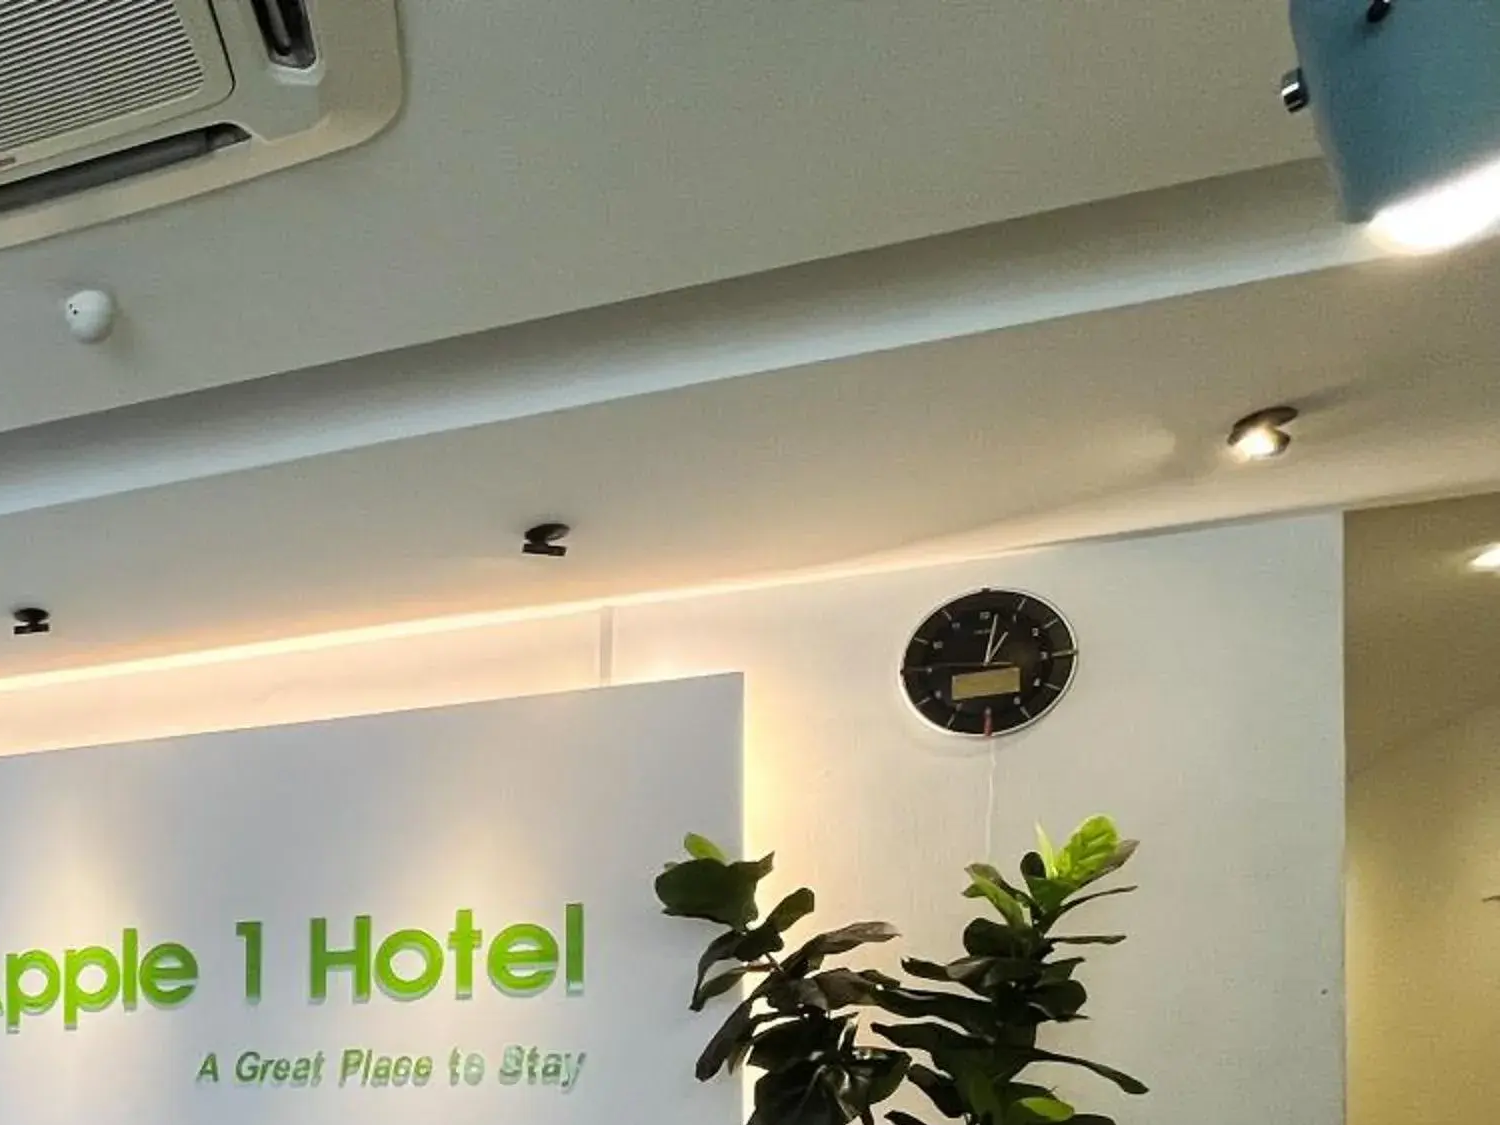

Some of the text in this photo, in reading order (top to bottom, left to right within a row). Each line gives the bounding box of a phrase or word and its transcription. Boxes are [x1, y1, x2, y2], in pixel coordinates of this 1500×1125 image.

[235, 921, 263, 1006] 1
[310, 903, 584, 1001] Hotel
[198, 1045, 587, 1093] A Great Place to Stay
